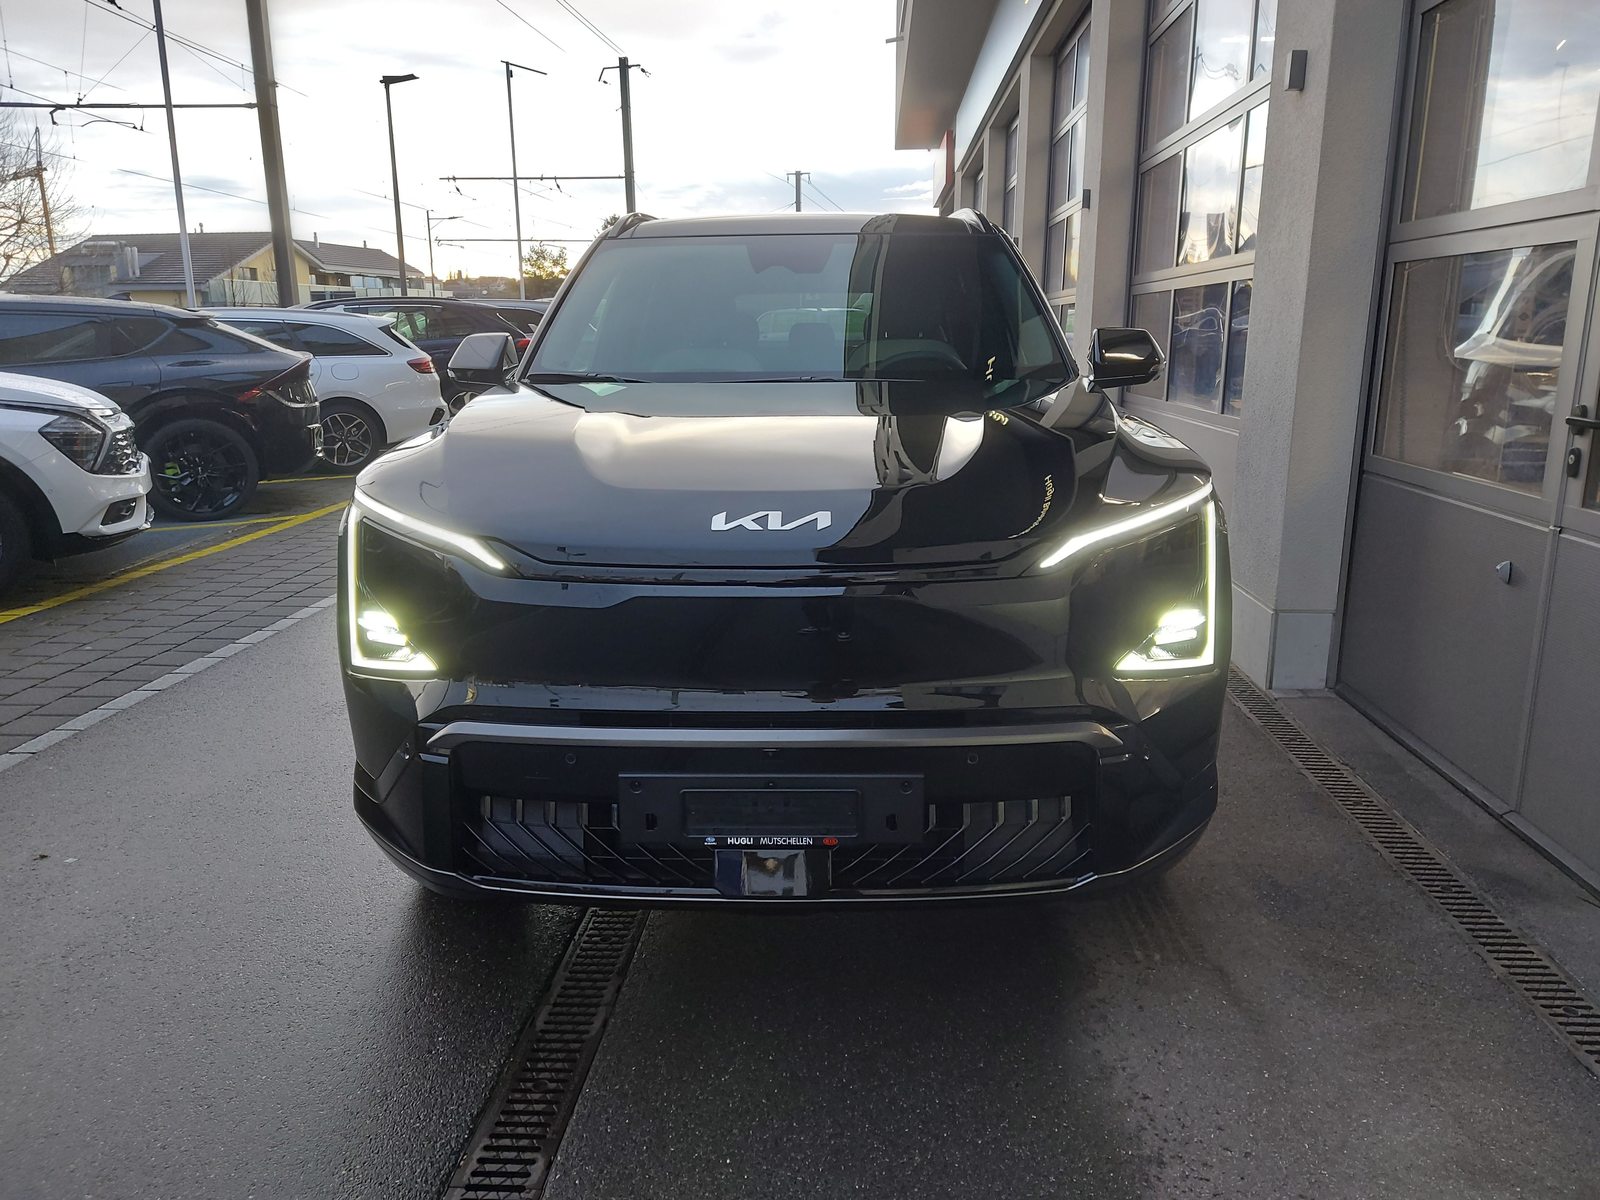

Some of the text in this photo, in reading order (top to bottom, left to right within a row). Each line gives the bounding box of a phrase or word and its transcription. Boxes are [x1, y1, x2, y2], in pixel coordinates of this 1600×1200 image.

[710, 510, 832, 531] KIA
[727, 837, 813, 845] HUGLI MUTSCHELLEN
